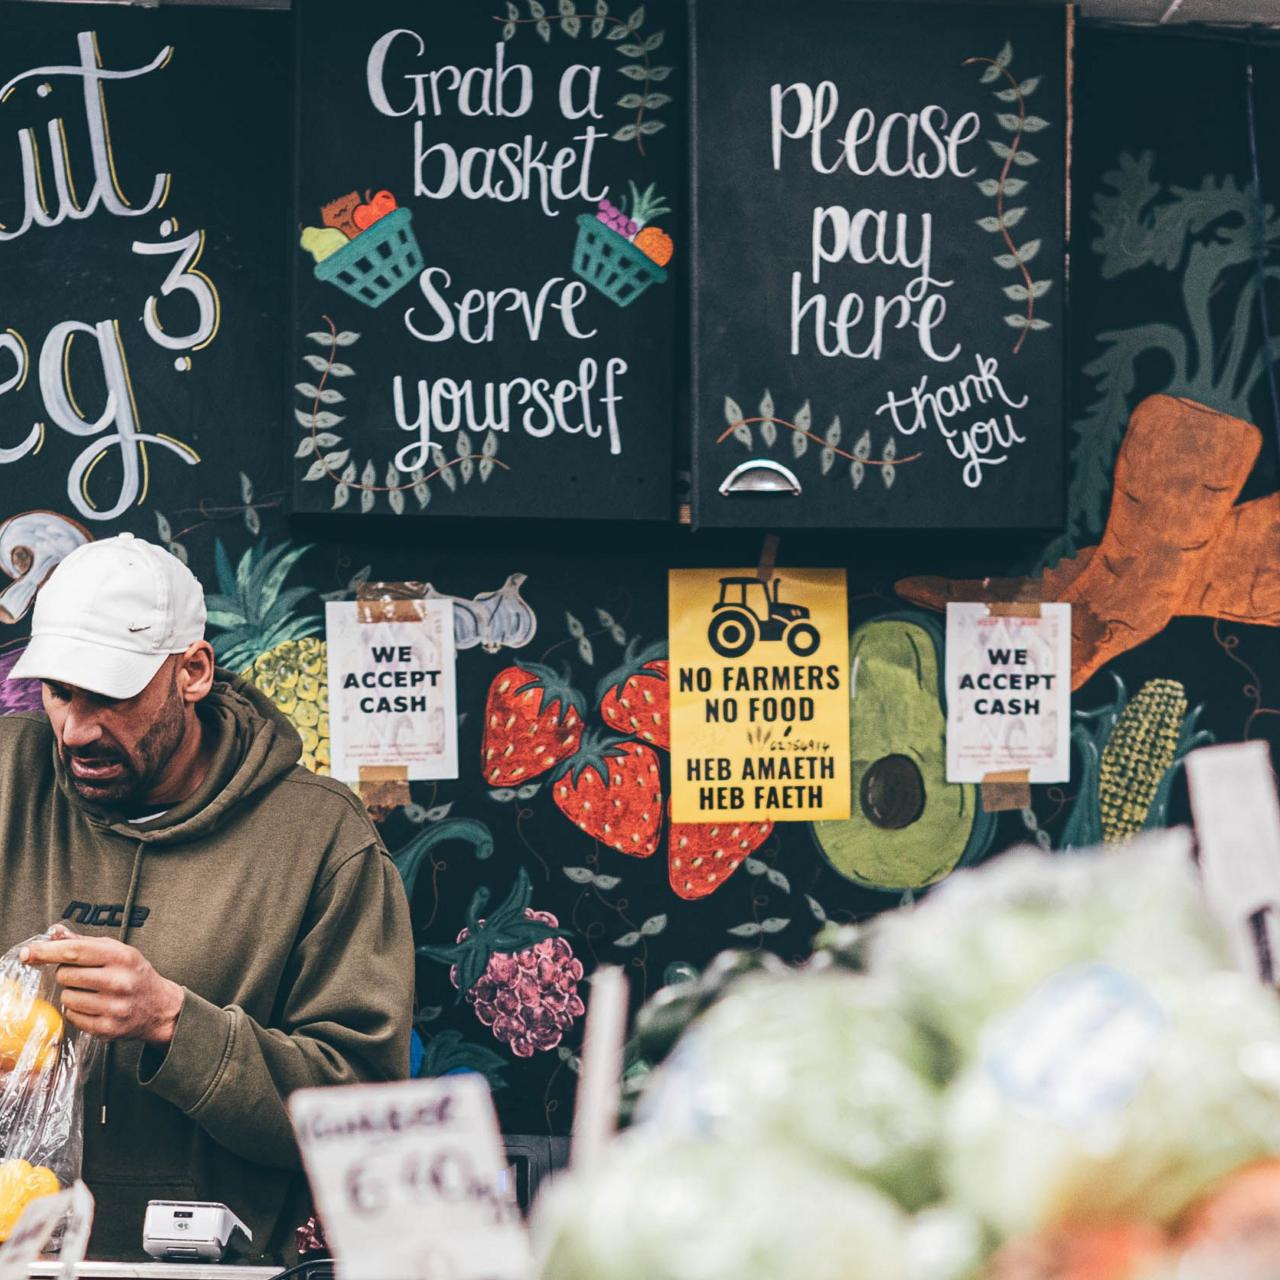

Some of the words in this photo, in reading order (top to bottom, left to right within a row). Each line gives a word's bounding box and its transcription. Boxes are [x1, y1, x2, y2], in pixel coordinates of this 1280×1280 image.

[366, 29, 533, 117] Grab
[559, 65, 604, 119] a
[770, 80, 980, 180] Please
[414, 121, 609, 216] basket
[812, 205, 954, 301] pay
[404, 267, 598, 343] Serve
[791, 271, 961, 362] here
[875, 353, 1029, 438] thank
[393, 358, 628, 473] yourself
[946, 414, 1027, 488] you
[372, 646, 412, 663] WE
[987, 648, 1028, 665] WE
[343, 670, 442, 689] ACCEPT
[679, 667, 712, 692] NO
[722, 664, 840, 691] FARMERS
[959, 674, 1056, 691] ACCEPT
[360, 696, 426, 714] CASH
[705, 697, 738, 723] NO
[749, 696, 814, 722] FOOD
[974, 698, 1040, 716] CASH
[686, 758, 731, 782] HEB
[741, 756, 835, 780] AMAETH
[699, 786, 744, 811] HEB
[754, 785, 824, 809] FAETH
